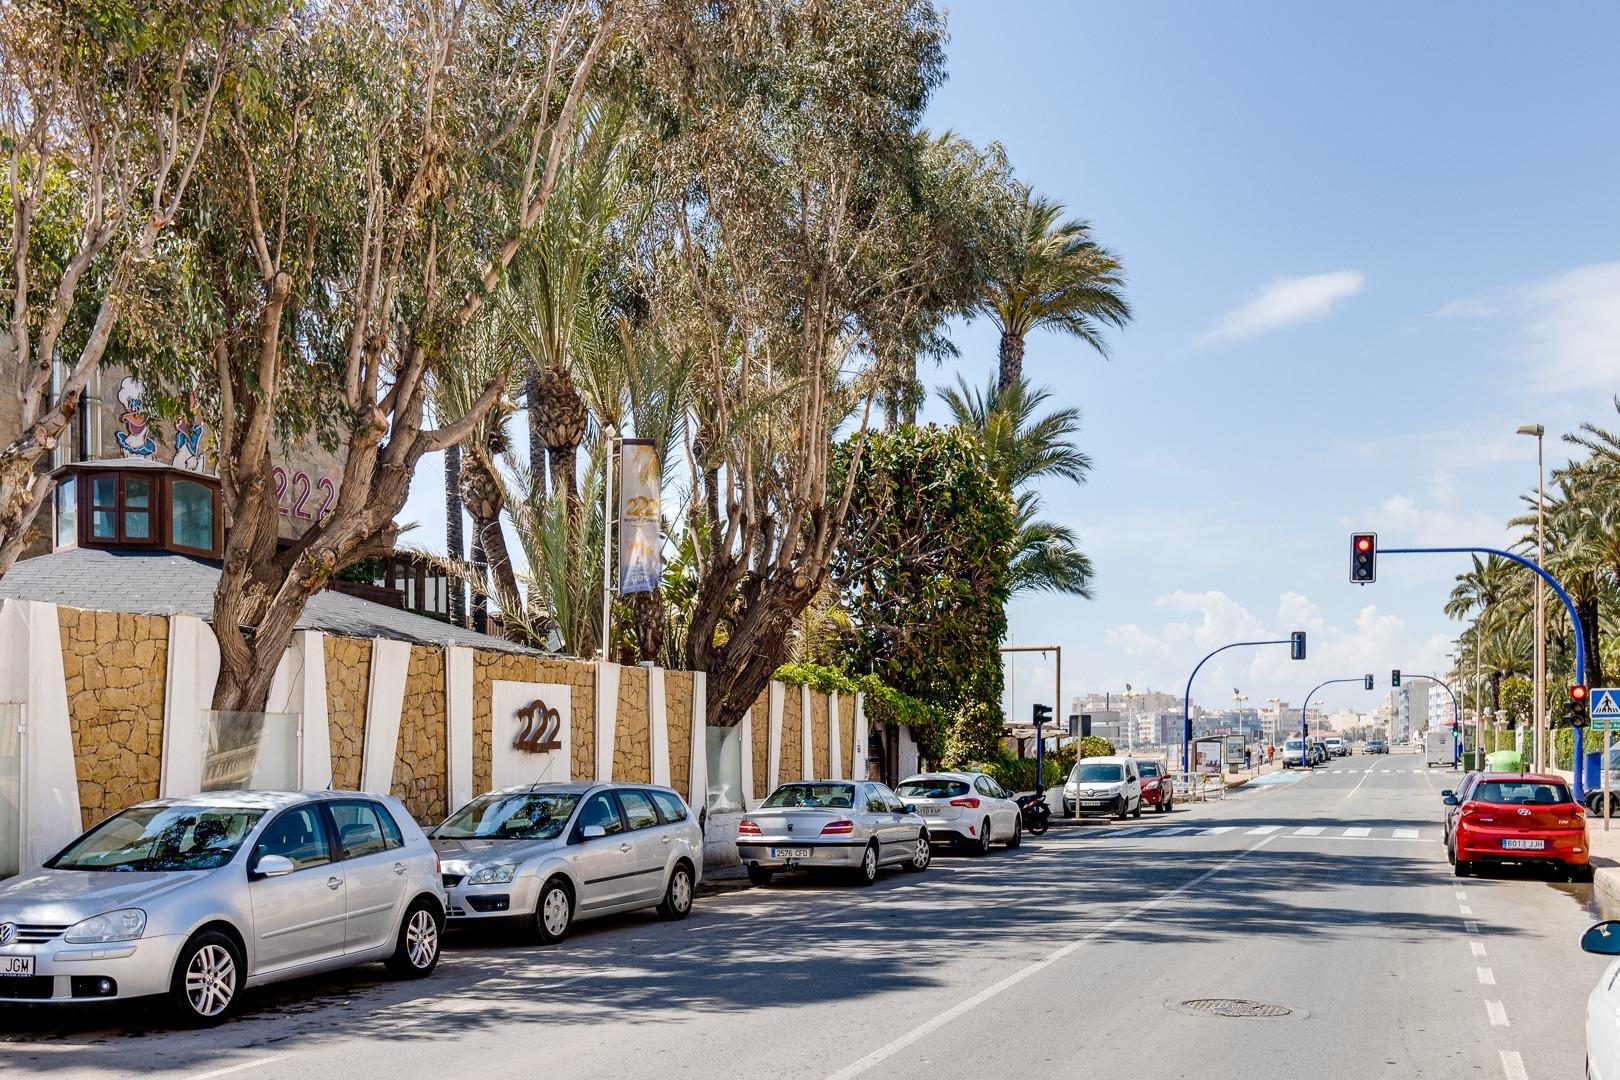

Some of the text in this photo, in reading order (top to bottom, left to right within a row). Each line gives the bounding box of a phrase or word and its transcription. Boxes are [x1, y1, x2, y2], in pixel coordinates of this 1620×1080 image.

[625, 495, 659, 516] 222
[514, 699, 562, 754] 222
[5, 958, 29, 972] JGM
